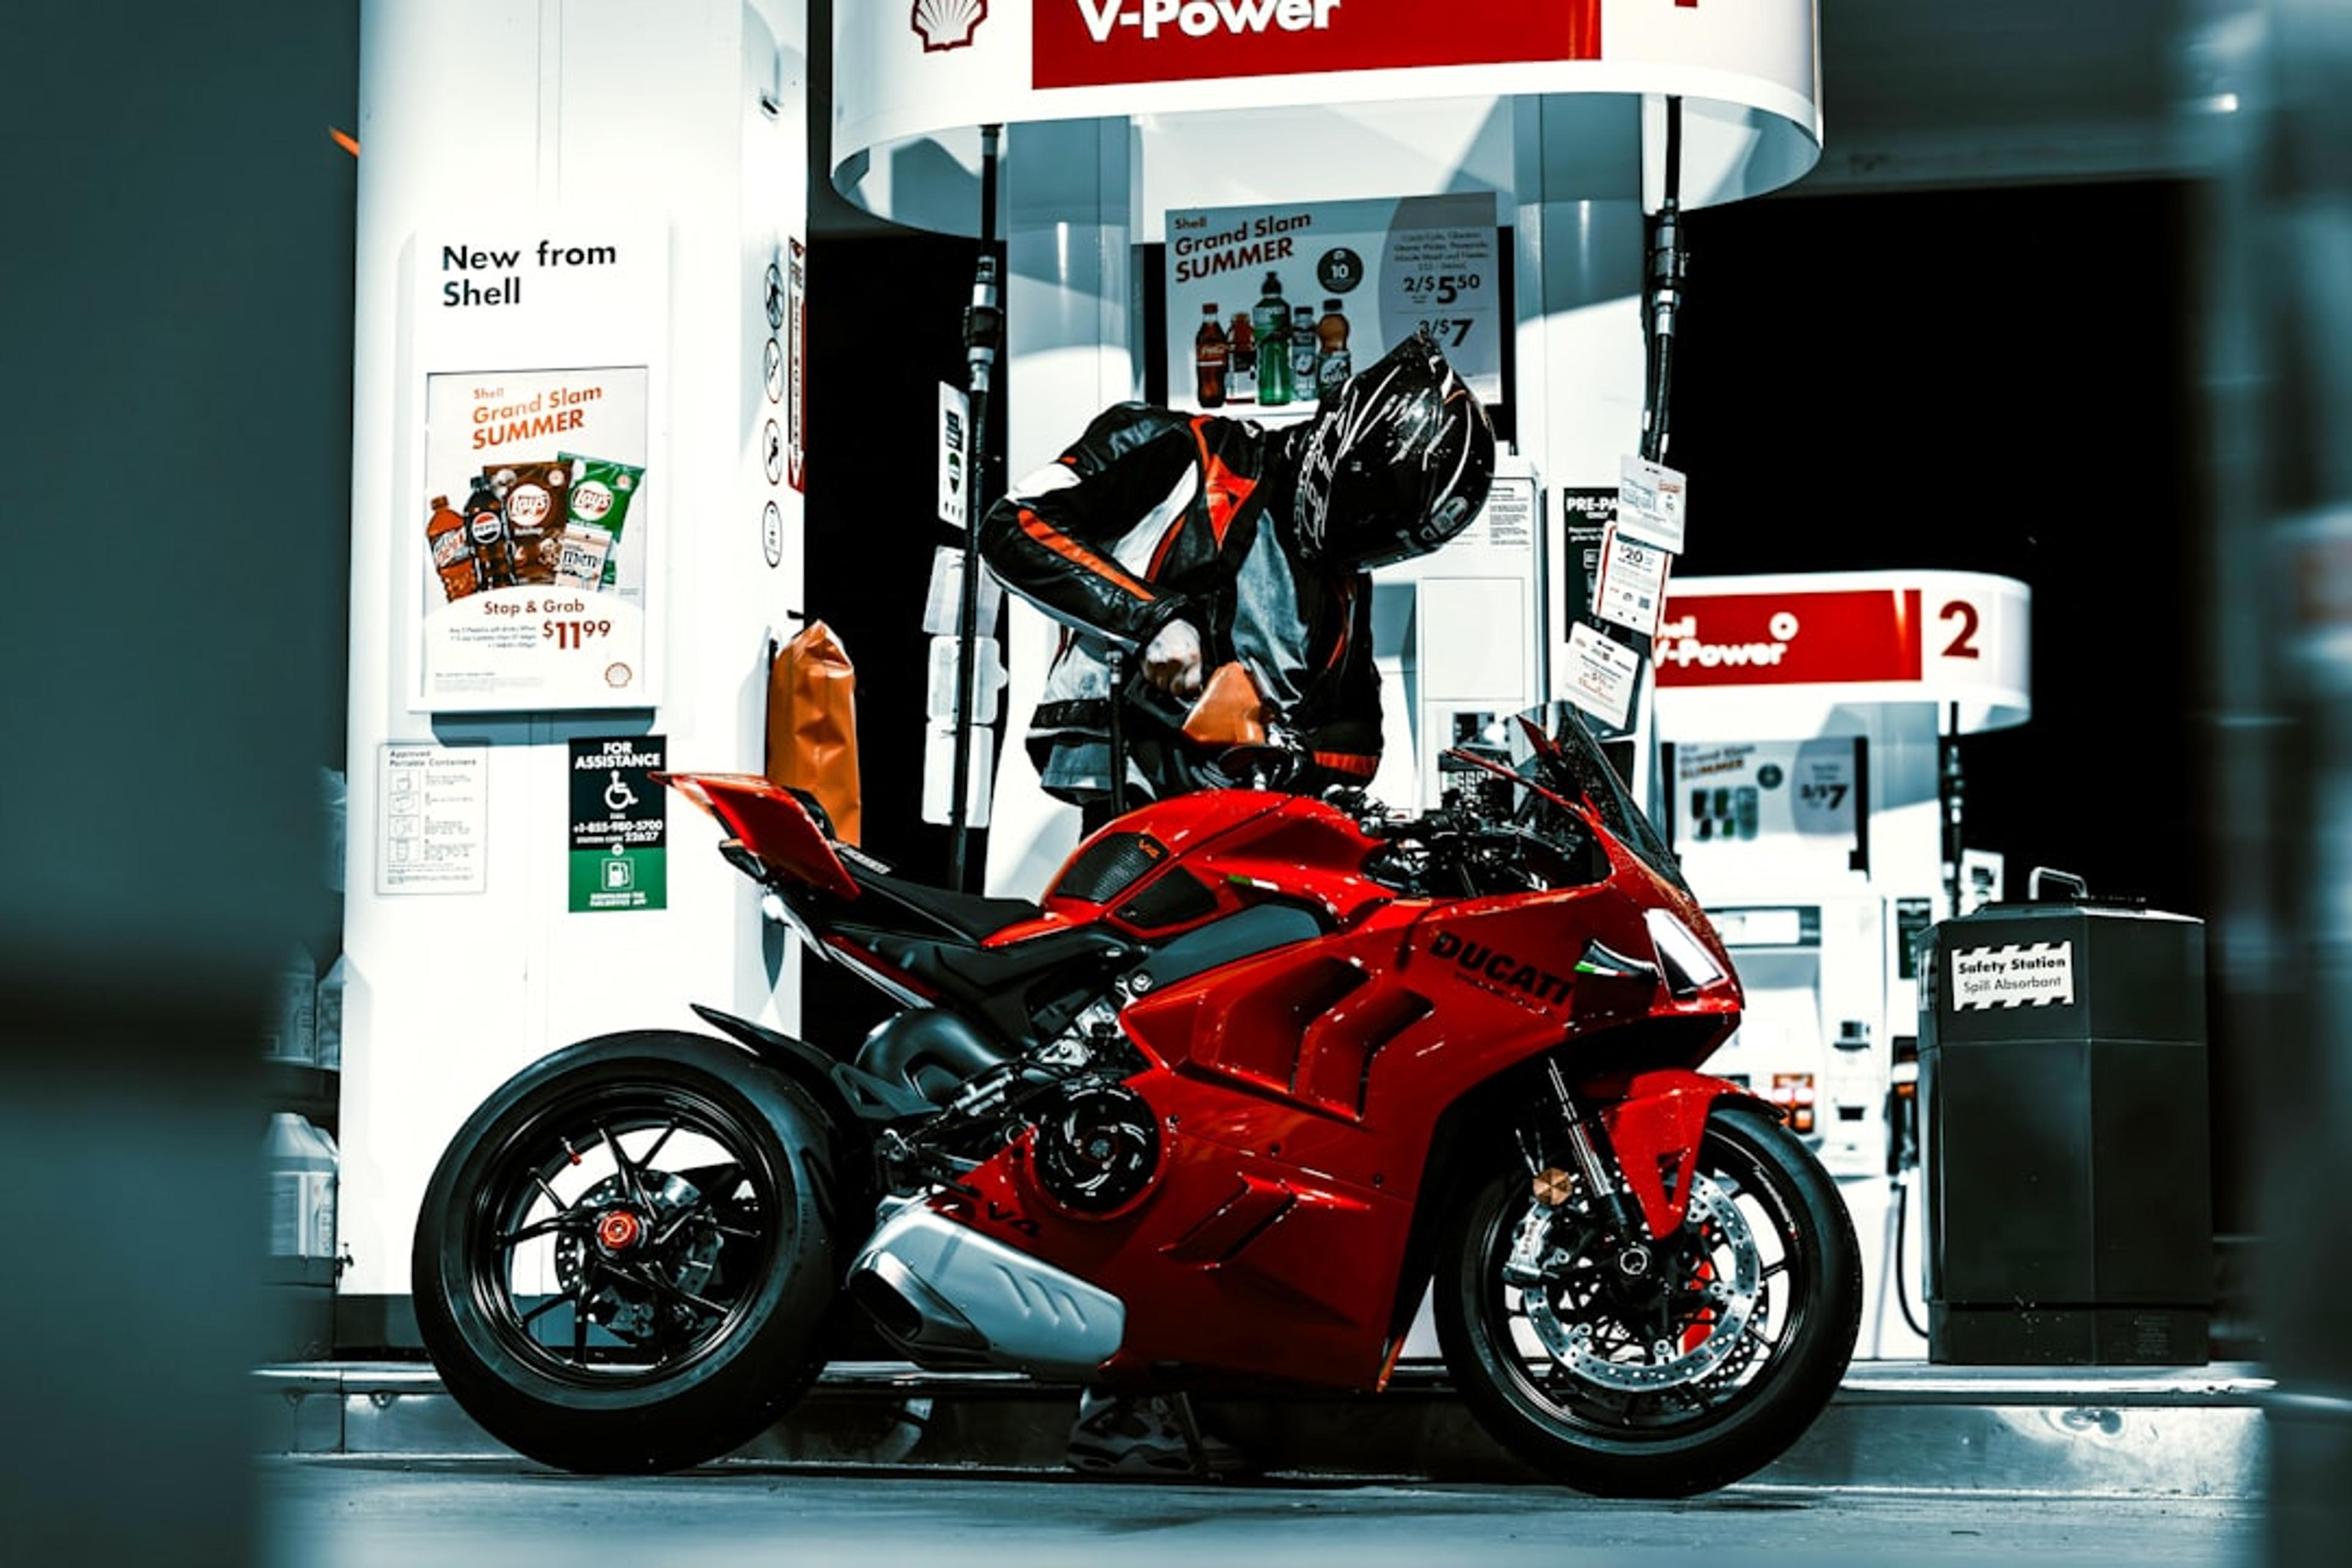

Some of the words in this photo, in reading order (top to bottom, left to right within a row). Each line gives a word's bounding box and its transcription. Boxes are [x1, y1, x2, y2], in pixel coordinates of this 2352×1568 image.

[1080, 0, 1340, 42] V-Power
[1175, 217, 1207, 230] Shell
[1175, 225, 1248, 257] Grand
[1254, 212, 1311, 238] Slam
[442, 245, 519, 270] New
[537, 240, 616, 266] from
[1175, 238, 1294, 282] SUMMER
[1331, 264, 1349, 278] 10
[443, 277, 520, 307] Shell
[472, 395, 541, 424] Grand
[549, 385, 603, 409] Slam
[473, 388, 505, 399] Shell
[471, 409, 584, 450] SUMMER
[484, 601, 521, 616] Stop
[526, 600, 537, 613] &
[543, 598, 585, 613] Grab
[1939, 601, 1979, 659] 2
[575, 753, 660, 769] ASSISTANCE
[603, 742, 632, 755] FOR
[1429, 930, 1572, 1005] DUCATI
[1958, 961, 2005, 974] Safety
[2010, 957, 2065, 970] Station
[1964, 981, 1991, 994] Spill
[1995, 977, 2061, 990] Absorbant
